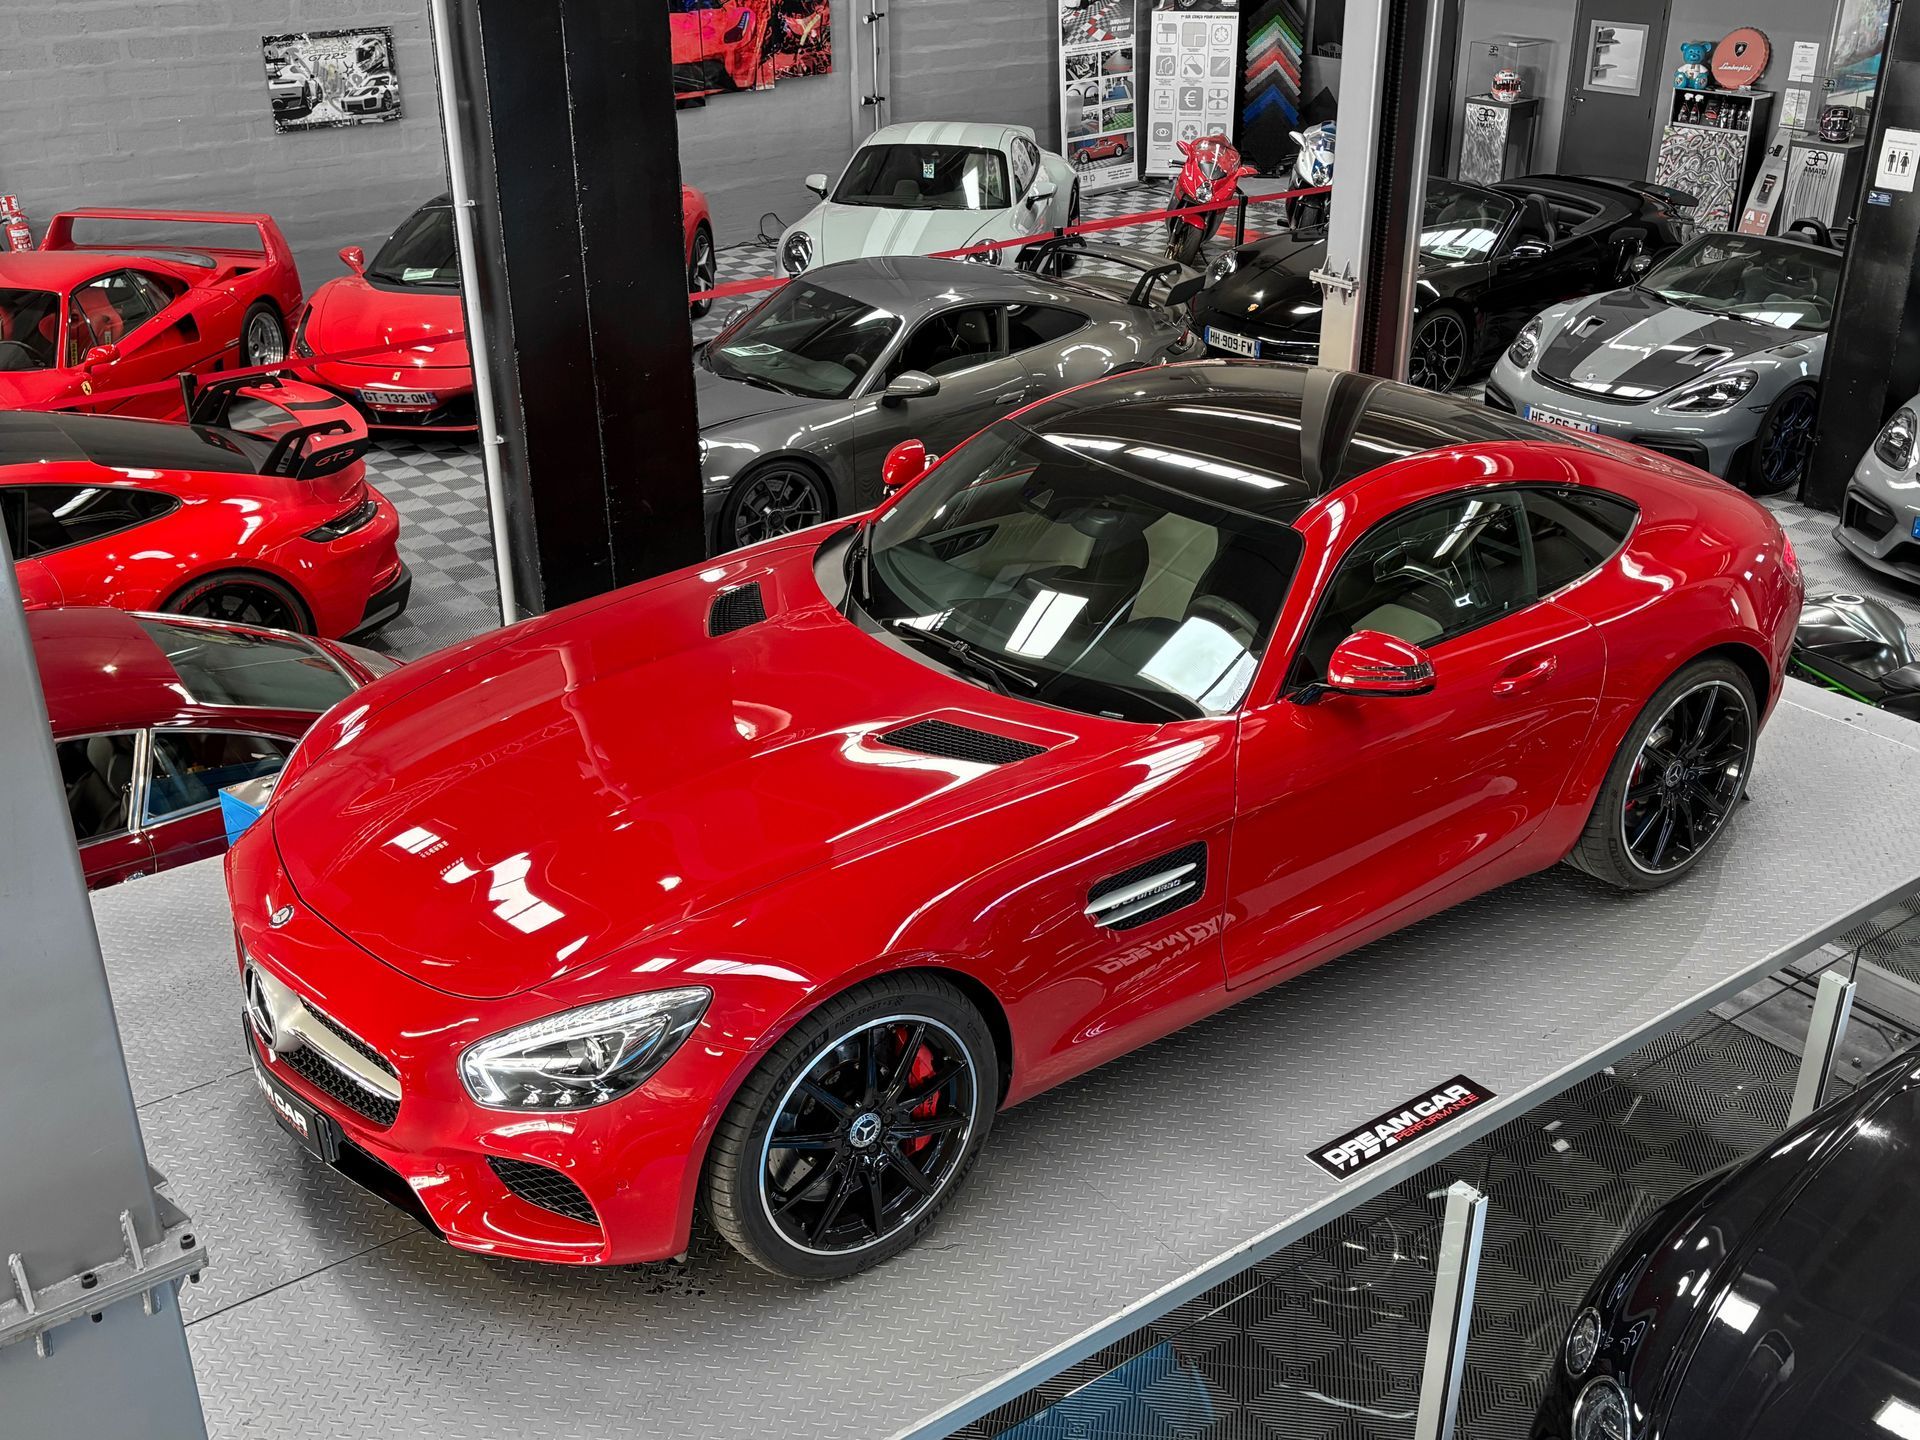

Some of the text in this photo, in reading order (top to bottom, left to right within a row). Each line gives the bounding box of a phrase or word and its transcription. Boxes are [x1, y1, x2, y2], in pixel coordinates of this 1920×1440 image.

[1719, 62, 1753, 72] Lamborghini
[1210, 330, 1253, 355] HH-909-FW
[315, 449, 354, 467] GT3
[273, 1092, 308, 1132] CAR
[1322, 1084, 1472, 1167] DREAM CAR
[1394, 1093, 1480, 1142] PERFORMANCE
